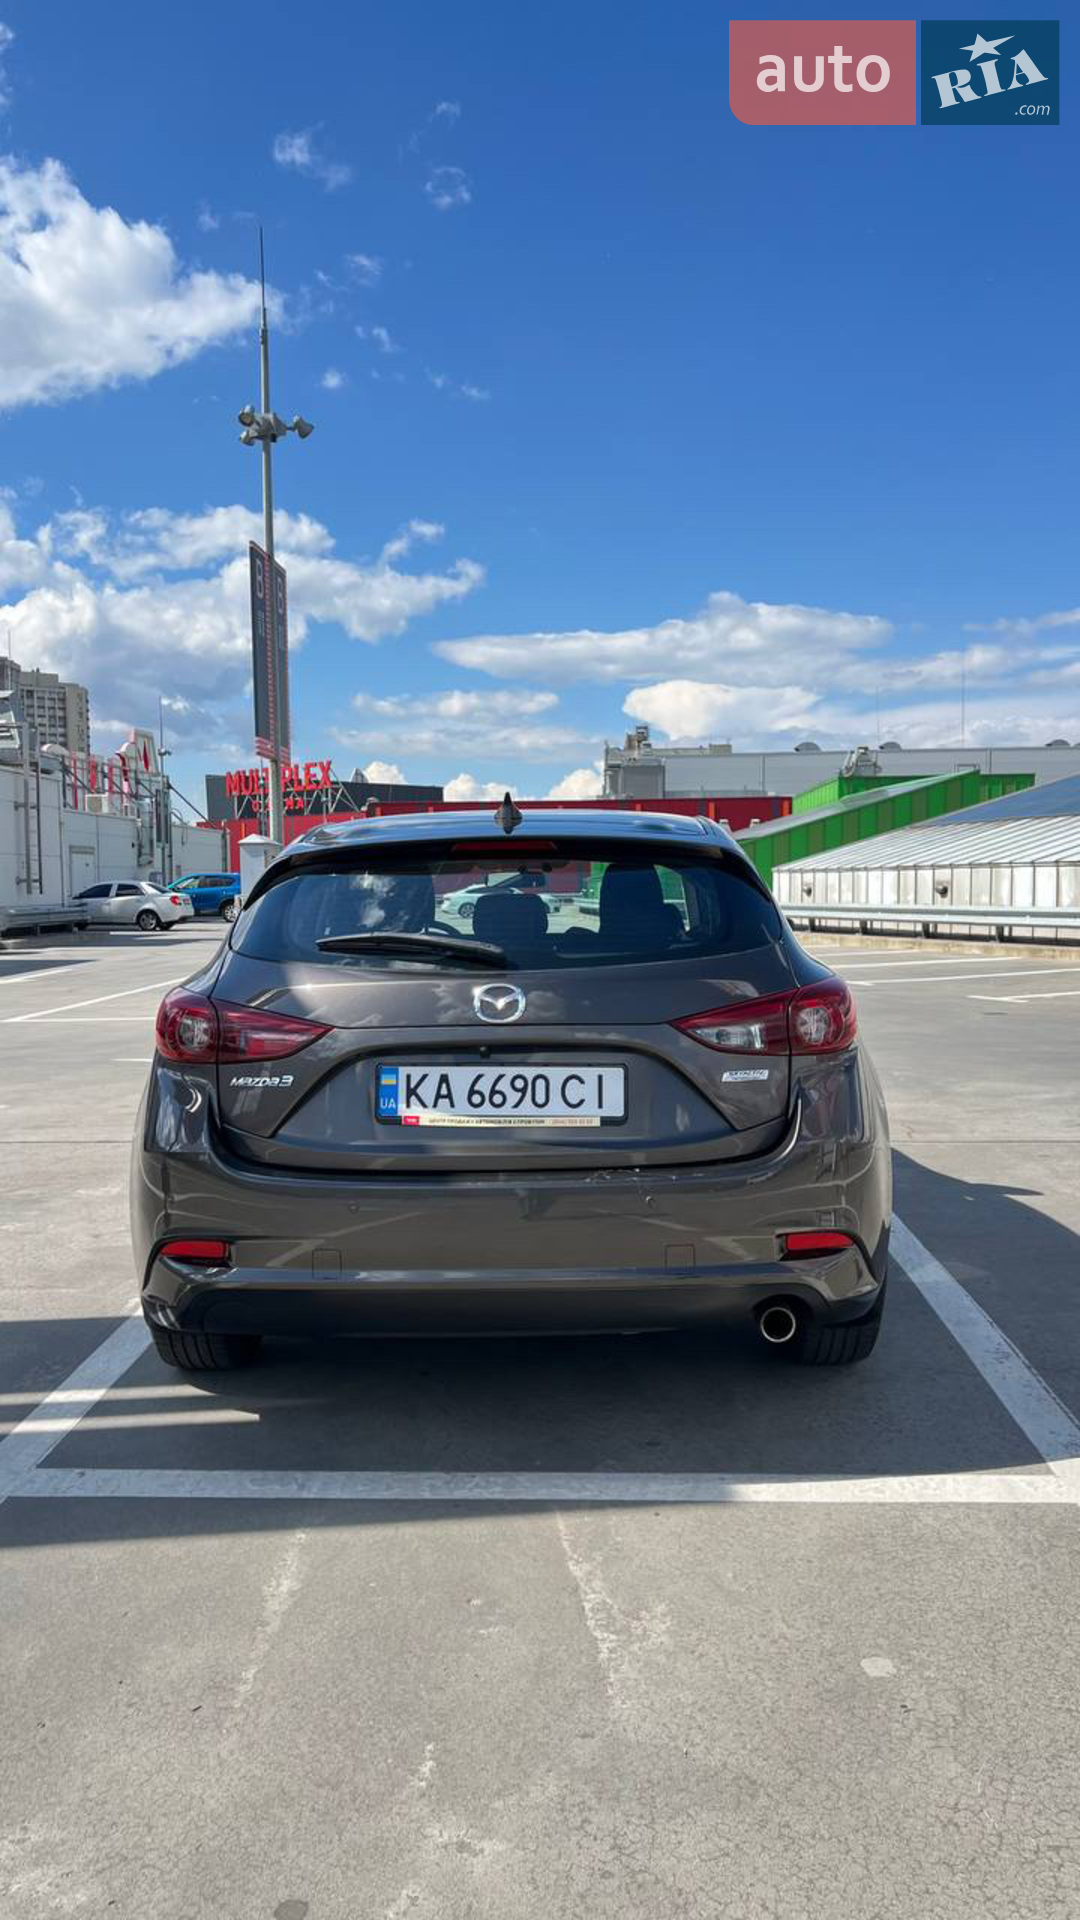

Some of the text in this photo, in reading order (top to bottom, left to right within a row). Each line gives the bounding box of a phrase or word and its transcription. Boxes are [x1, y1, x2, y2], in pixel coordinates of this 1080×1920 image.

[225, 761, 332, 797] MULTPLEX
[380, 1099, 396, 1110] UA
[405, 1073, 604, 1109] KA 6690 CI
